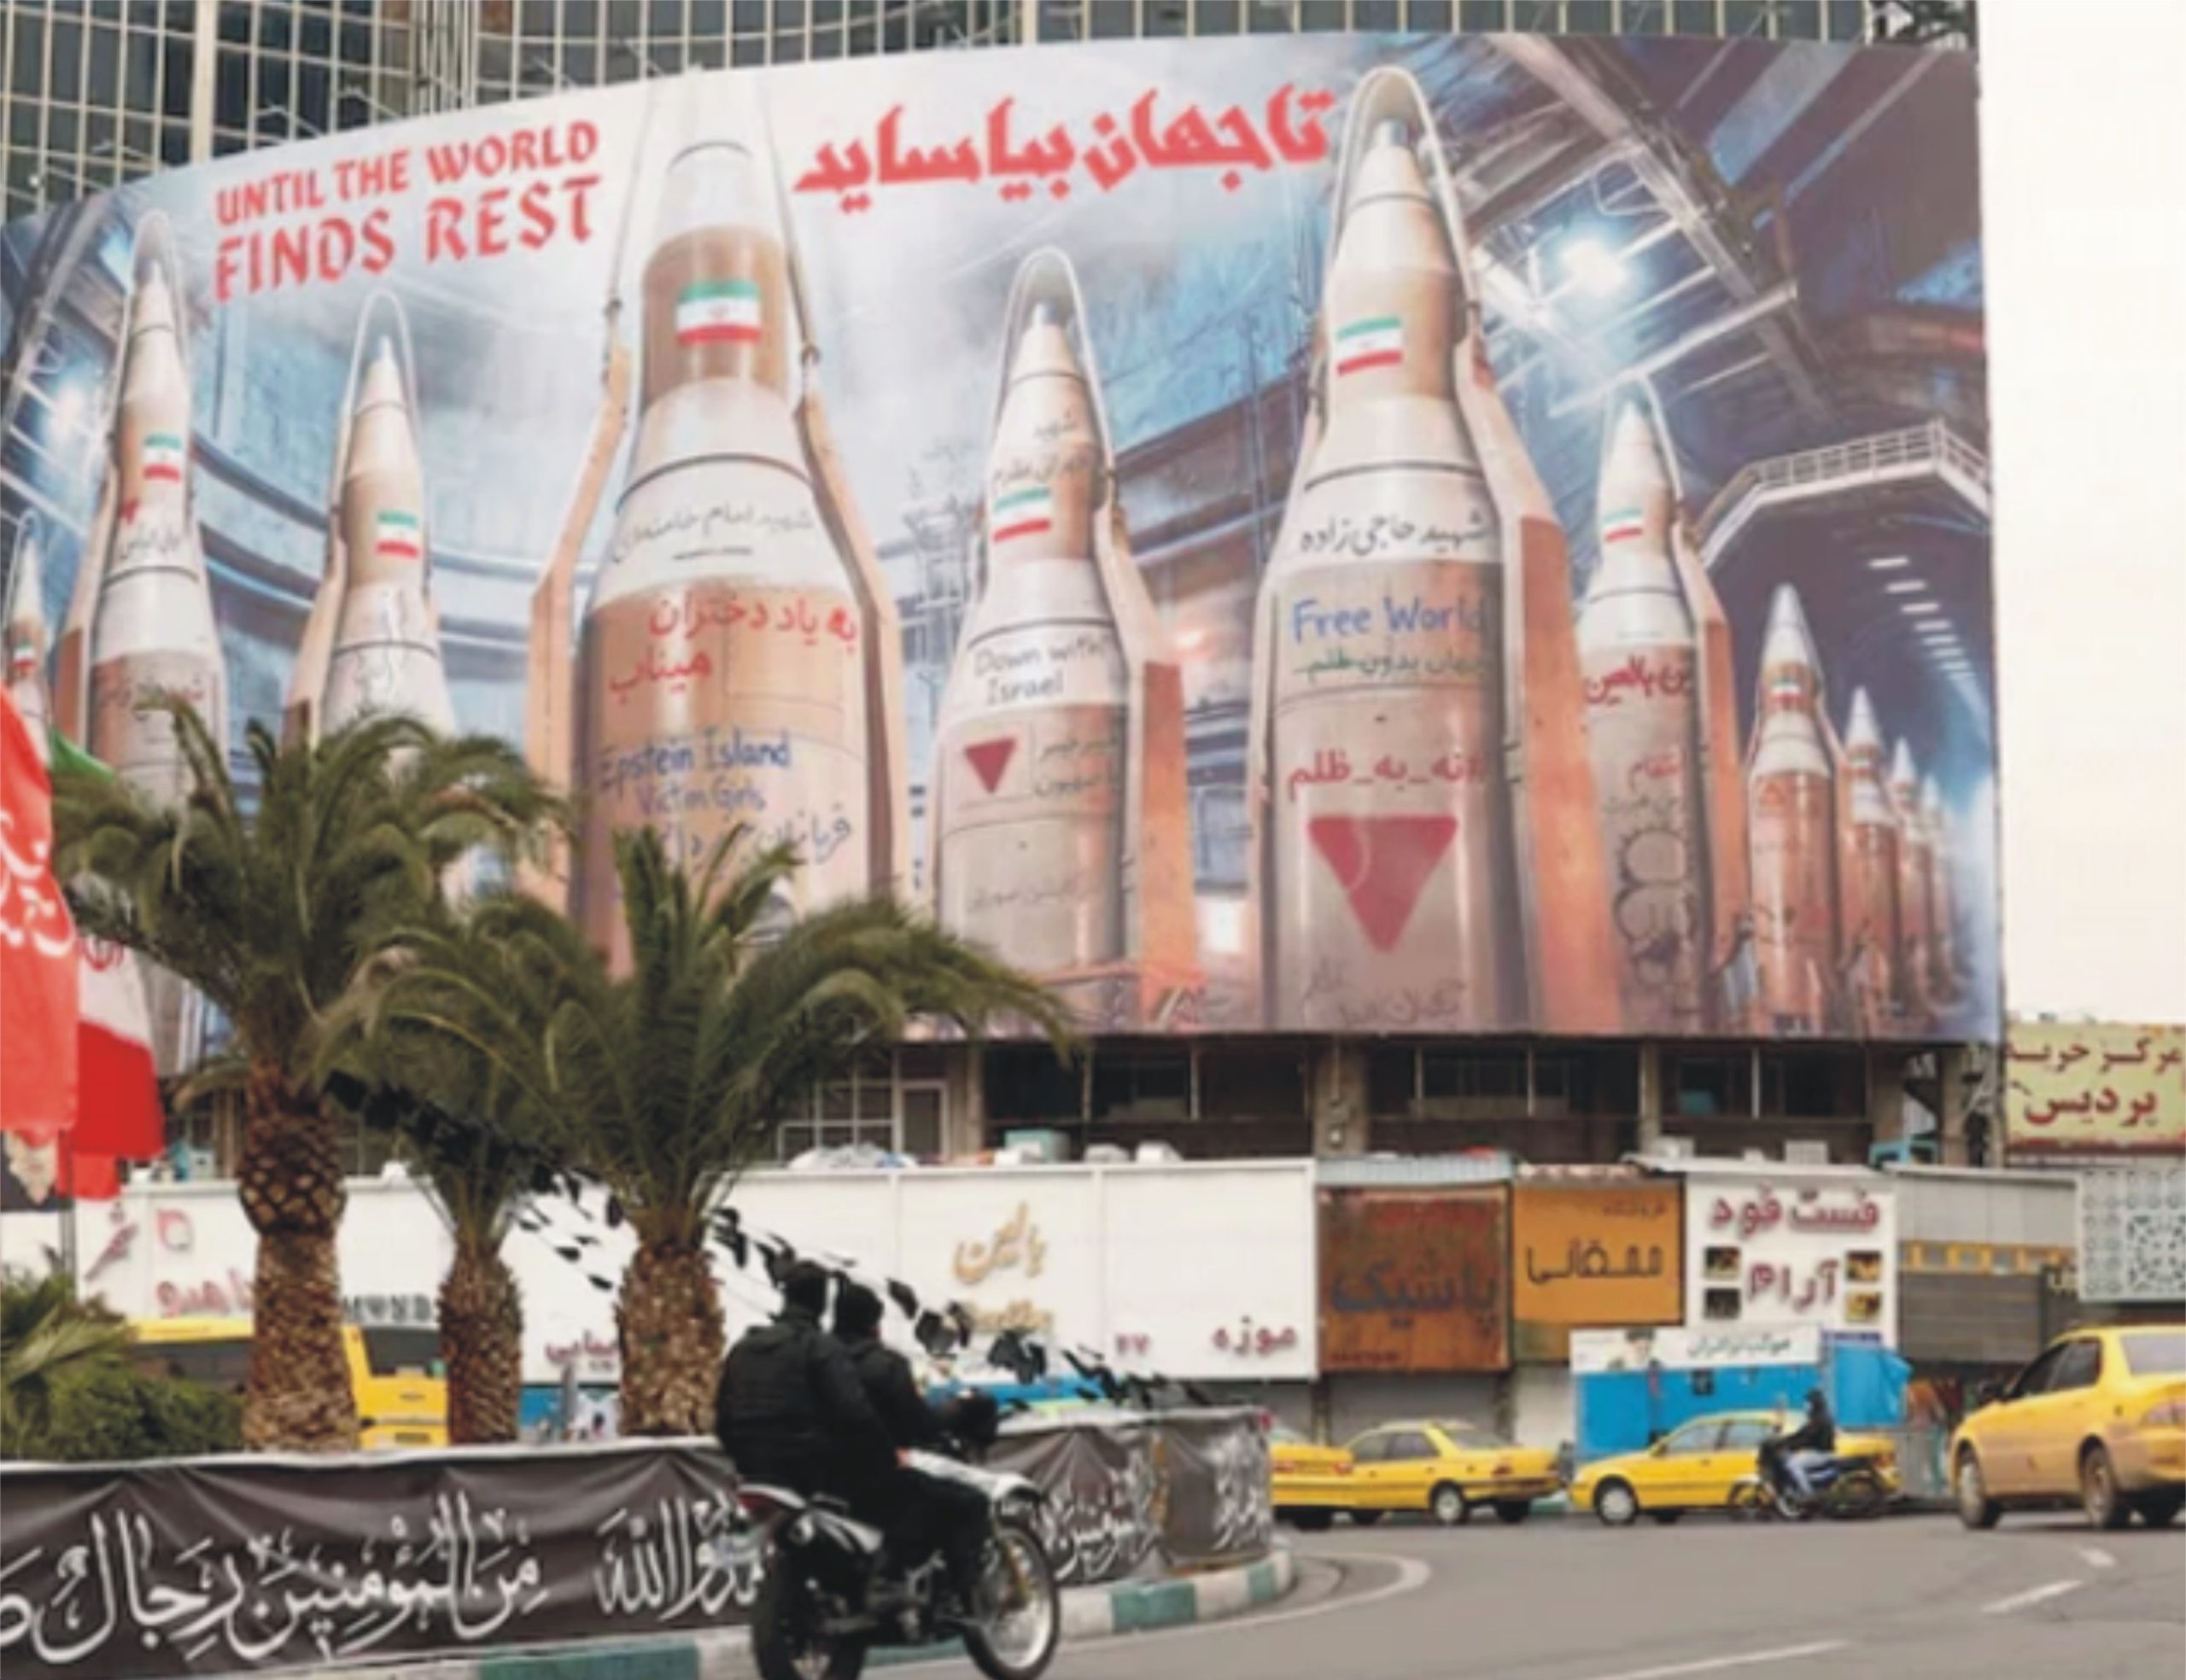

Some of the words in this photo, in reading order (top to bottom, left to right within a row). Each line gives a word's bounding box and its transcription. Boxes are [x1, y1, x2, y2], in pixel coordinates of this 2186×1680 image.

[1083, 87, 1272, 193] جهان
[1265, 82, 1336, 164] تا
[216, 168, 324, 227] UNTIL
[331, 148, 410, 203] THE
[425, 120, 600, 178] WORLD
[213, 207, 395, 305] FINDS
[425, 176, 602, 265] REST
[1292, 597, 1371, 643] Free
[704, 724, 792, 771] Island
[1711, 1181, 1783, 1238] فود
[1791, 1187, 1879, 1233] فست
[1747, 1257, 1839, 1313] آرام
